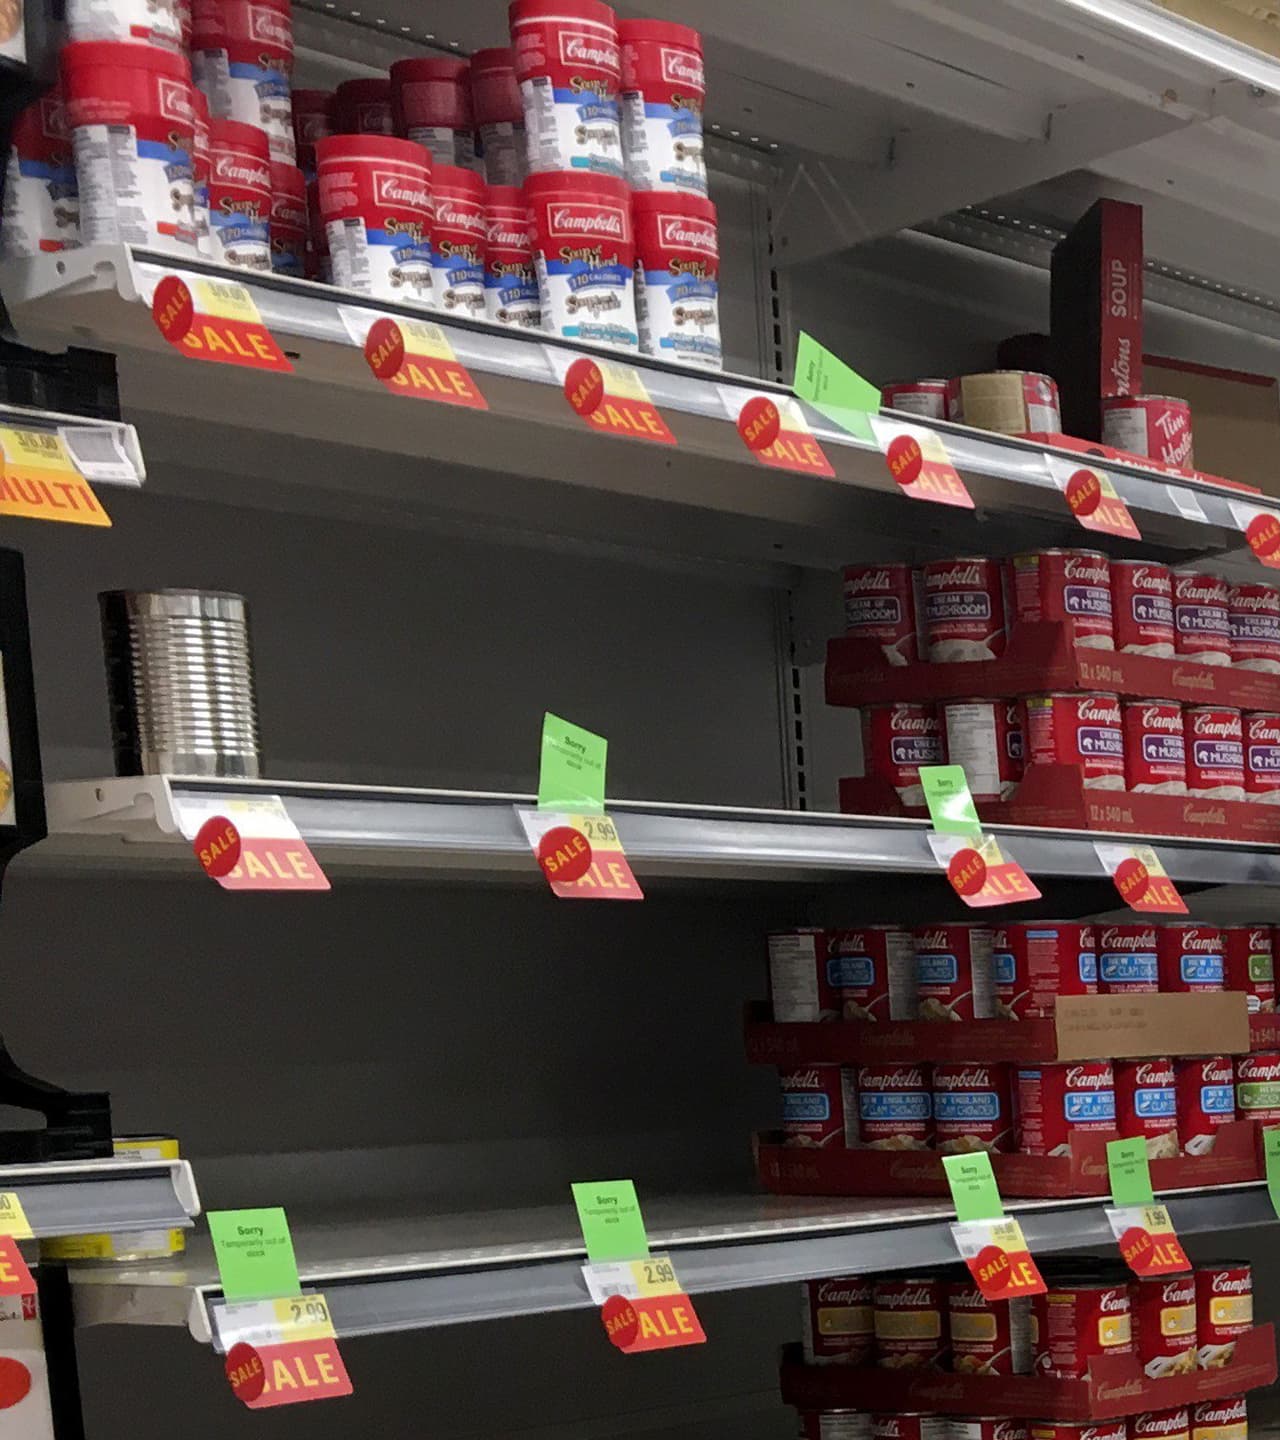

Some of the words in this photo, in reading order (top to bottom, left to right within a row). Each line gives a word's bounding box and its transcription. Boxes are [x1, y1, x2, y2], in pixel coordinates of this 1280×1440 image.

[1111, 258, 1127, 318] SOUP
[159, 284, 190, 329] SALE
[372, 327, 400, 371] SALE
[571, 366, 601, 409] SALE
[744, 405, 776, 441] SALE
[891, 443, 920, 476] SALE
[915, 469, 964, 498] ALE
[1068, 477, 1097, 511] SALE
[201, 826, 237, 867] SALE
[584, 821, 616, 841] 2.99
[545, 836, 586, 873] SALE
[953, 856, 982, 889] SALE
[1119, 865, 1147, 894] SALE
[236, 1225, 264, 1236] Sorry
[1145, 1211, 1167, 1228] 1.99
[1124, 1235, 1151, 1263] SALE
[643, 1263, 674, 1285] 2.99
[979, 1254, 1009, 1282] SALE
[290, 1301, 328, 1323] 2.99
[605, 1307, 635, 1336] SALE
[639, 1306, 694, 1339] ALE
[229, 1356, 262, 1388] SALE
[263, 1352, 339, 1394] ALE
